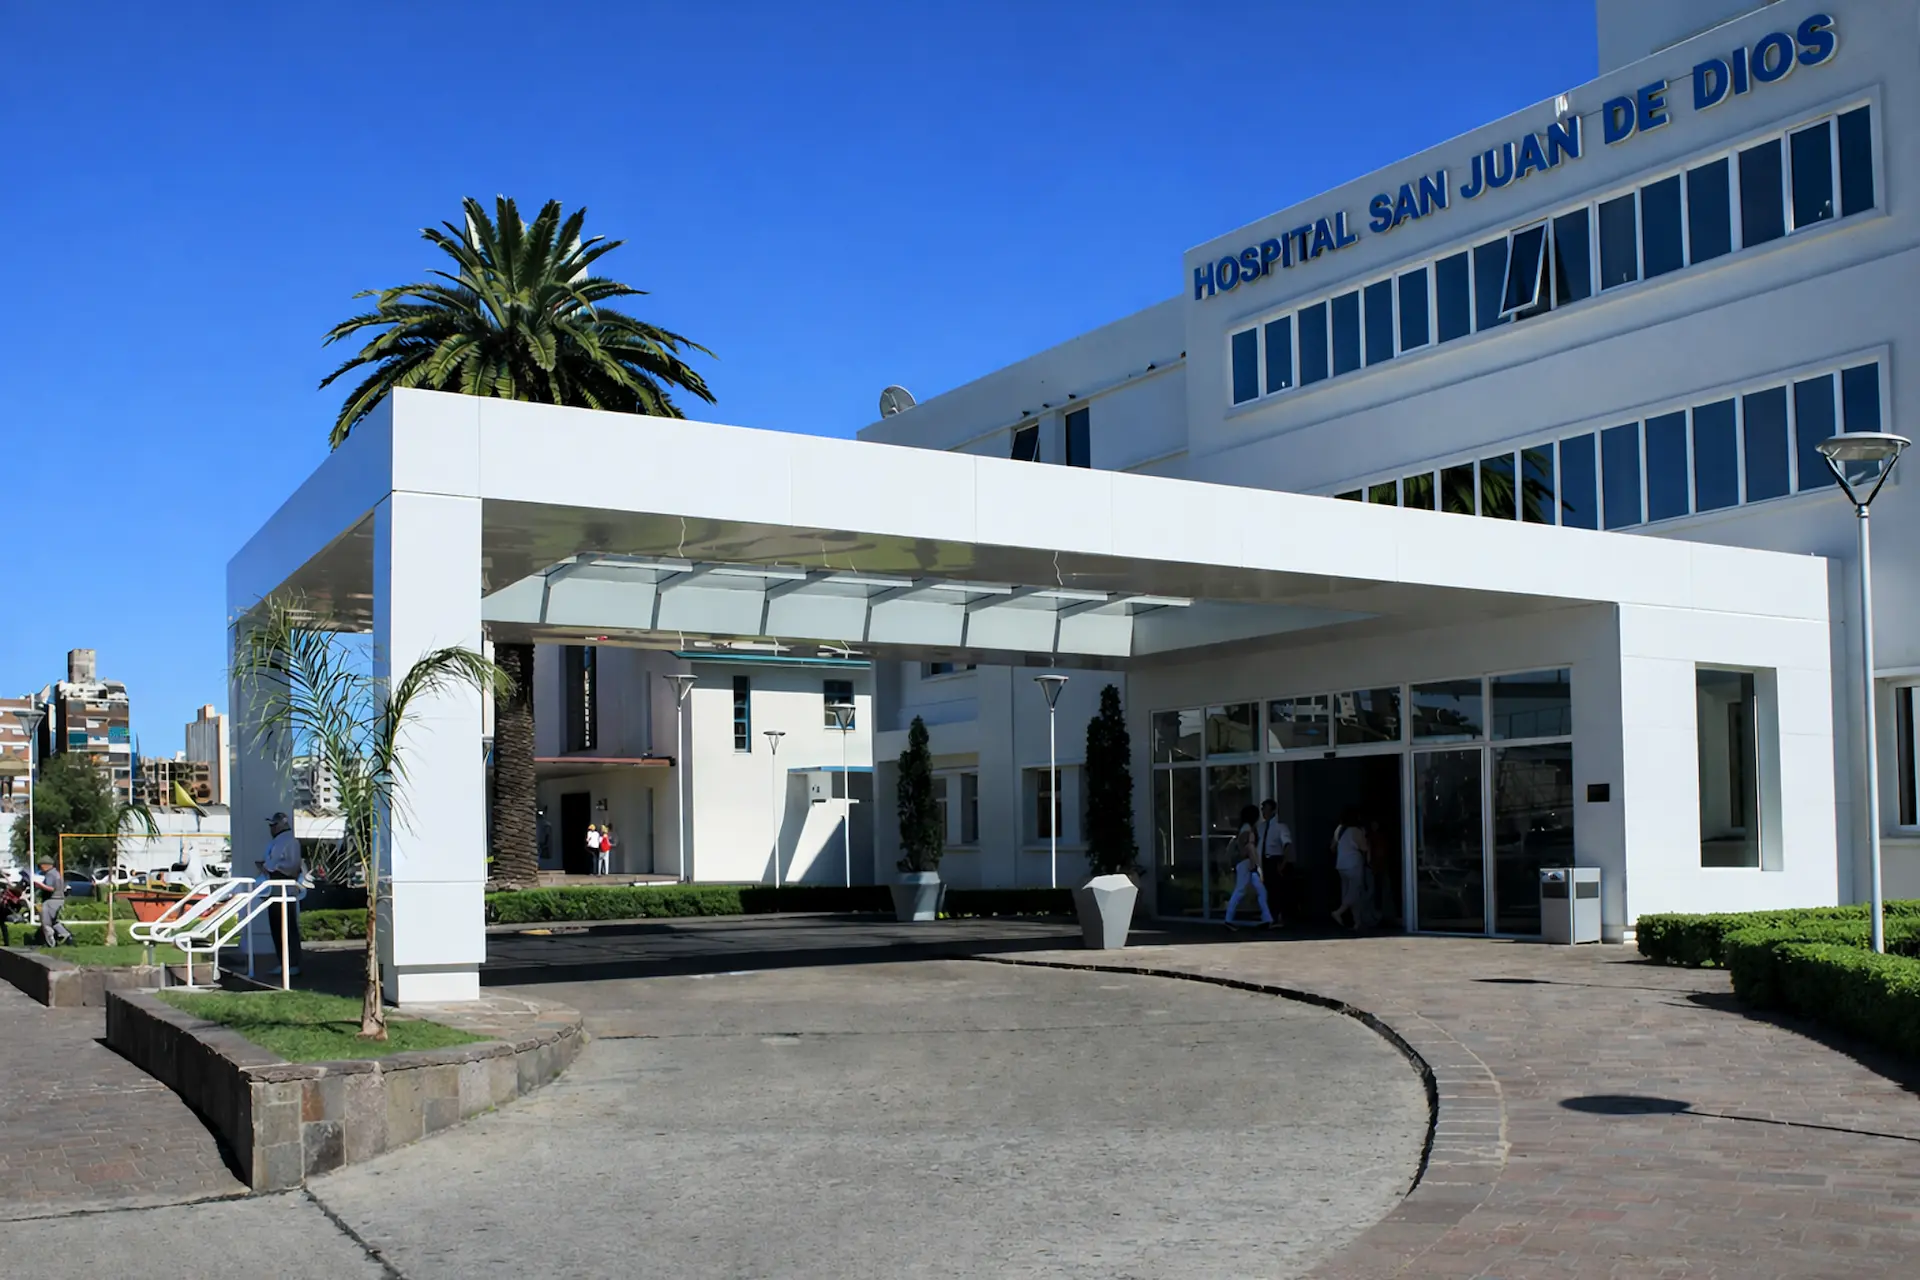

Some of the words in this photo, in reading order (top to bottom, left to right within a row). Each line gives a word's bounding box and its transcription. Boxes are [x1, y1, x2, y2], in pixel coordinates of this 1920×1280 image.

[1194, 211, 1358, 300] HOSPITAL
[1369, 169, 1449, 234] SAN
[1460, 114, 1583, 199] JUAN
[1602, 80, 1670, 145] DE
[1692, 14, 1838, 111] DIOS
